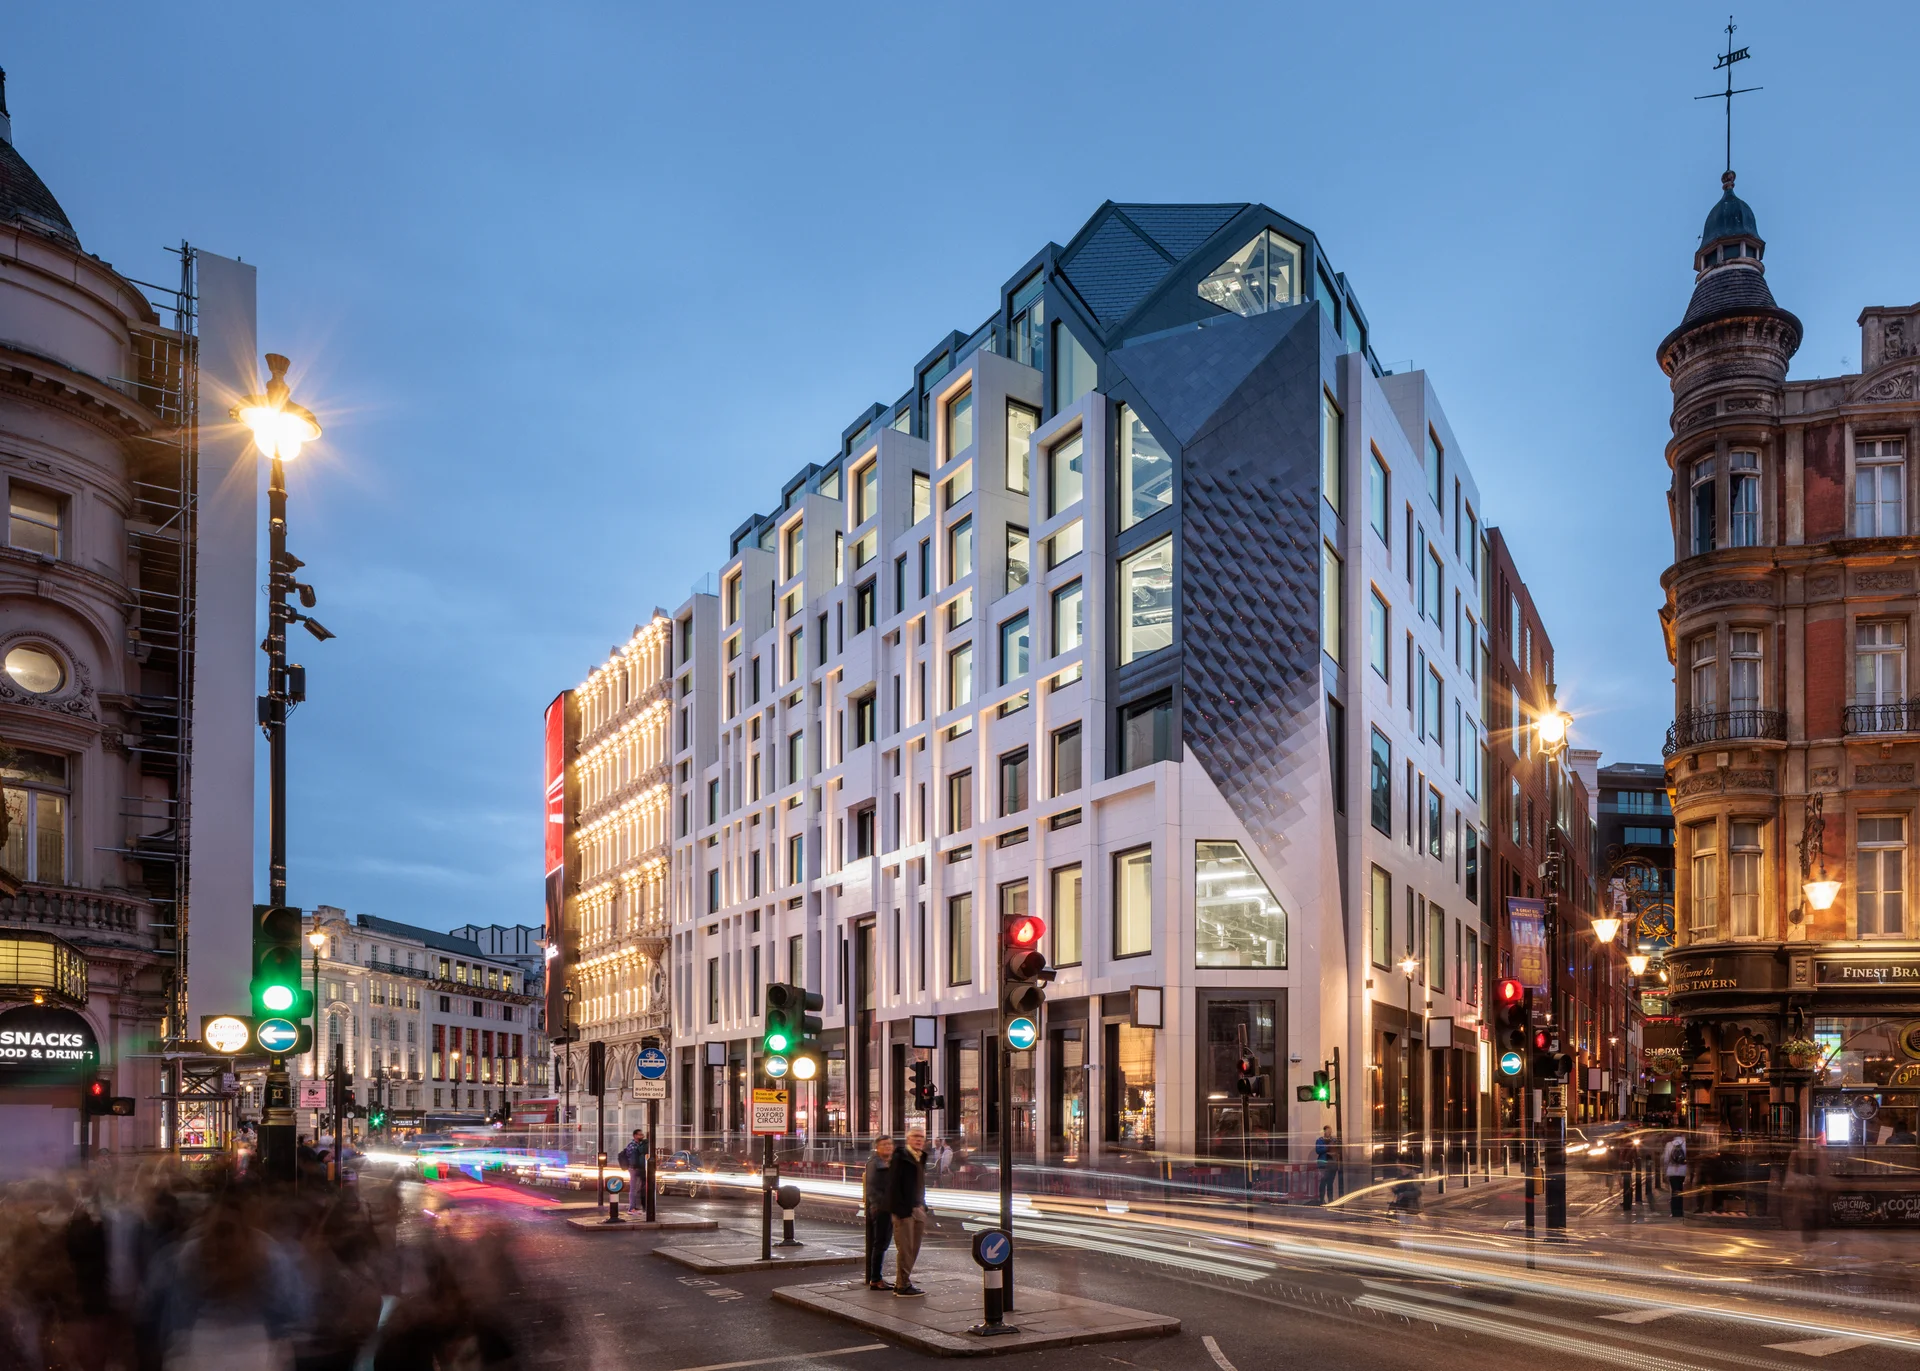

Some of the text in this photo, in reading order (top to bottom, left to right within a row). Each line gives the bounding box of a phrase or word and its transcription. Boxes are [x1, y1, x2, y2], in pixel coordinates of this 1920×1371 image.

[1703, 967, 1714, 976] to
[1843, 967, 1888, 978] FINEST
[1692, 979, 1737, 990] TAVERN
[0, 1031, 83, 1047] SNACKS
[31, 1049, 43, 1059] &
[1832, 1200, 1848, 1212] FISH
[1849, 1200, 1872, 1211] CHIPS
